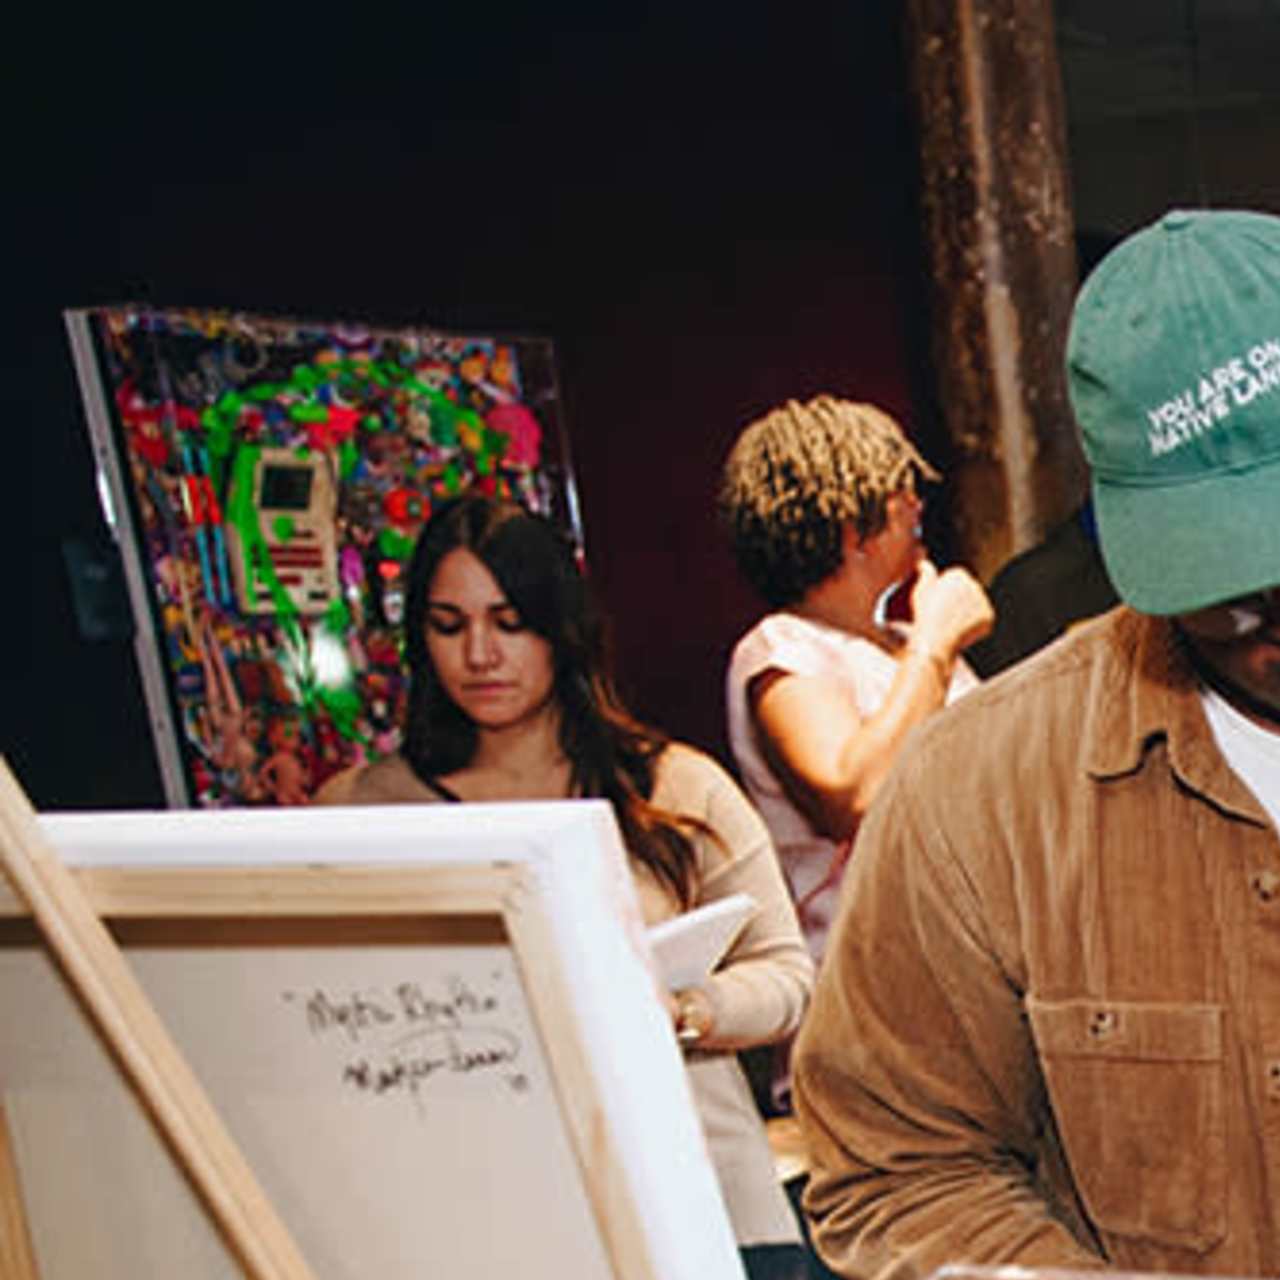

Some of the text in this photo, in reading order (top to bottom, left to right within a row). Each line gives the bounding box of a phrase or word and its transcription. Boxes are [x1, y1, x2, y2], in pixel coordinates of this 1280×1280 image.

[1147, 389, 1196, 430] YOU
[1198, 358, 1245, 404] ARE
[1149, 391, 1230, 456] NATIVE
